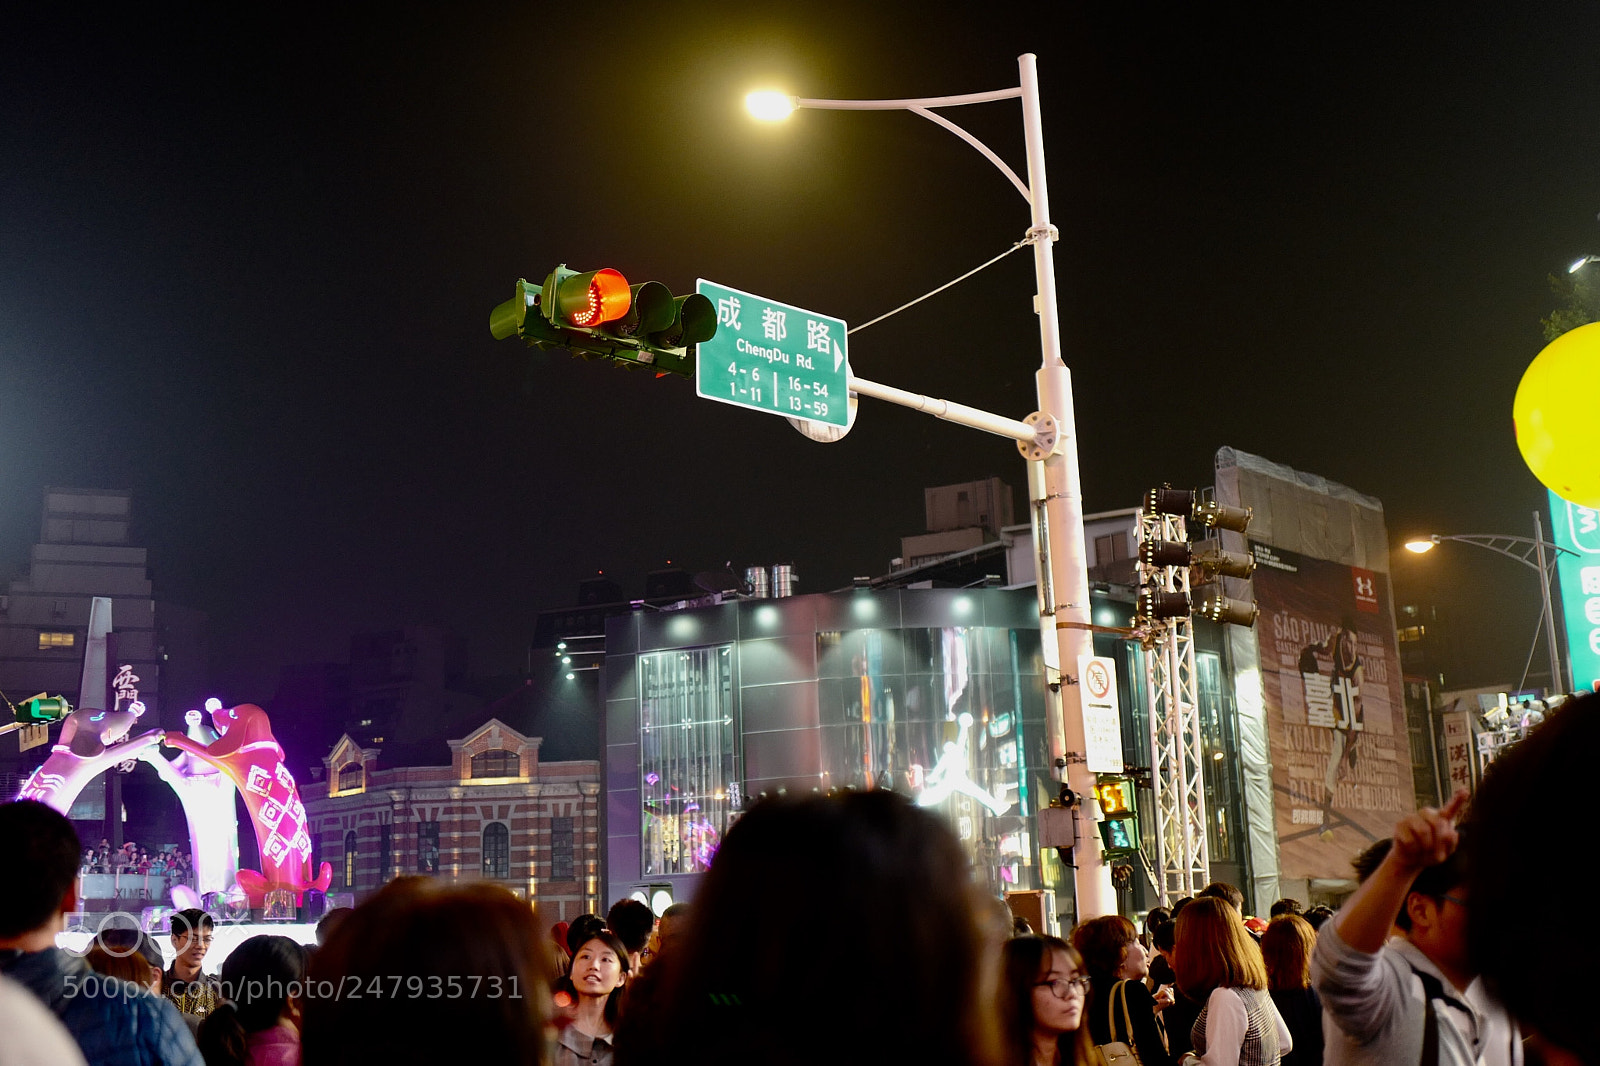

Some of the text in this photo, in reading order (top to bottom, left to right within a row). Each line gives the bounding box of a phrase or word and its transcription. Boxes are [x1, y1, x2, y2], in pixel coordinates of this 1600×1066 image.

[717, 296, 831, 354] 成都路
[736, 338, 815, 370] ChengDu Rd.
[1273, 609, 1300, 642] SÃO
